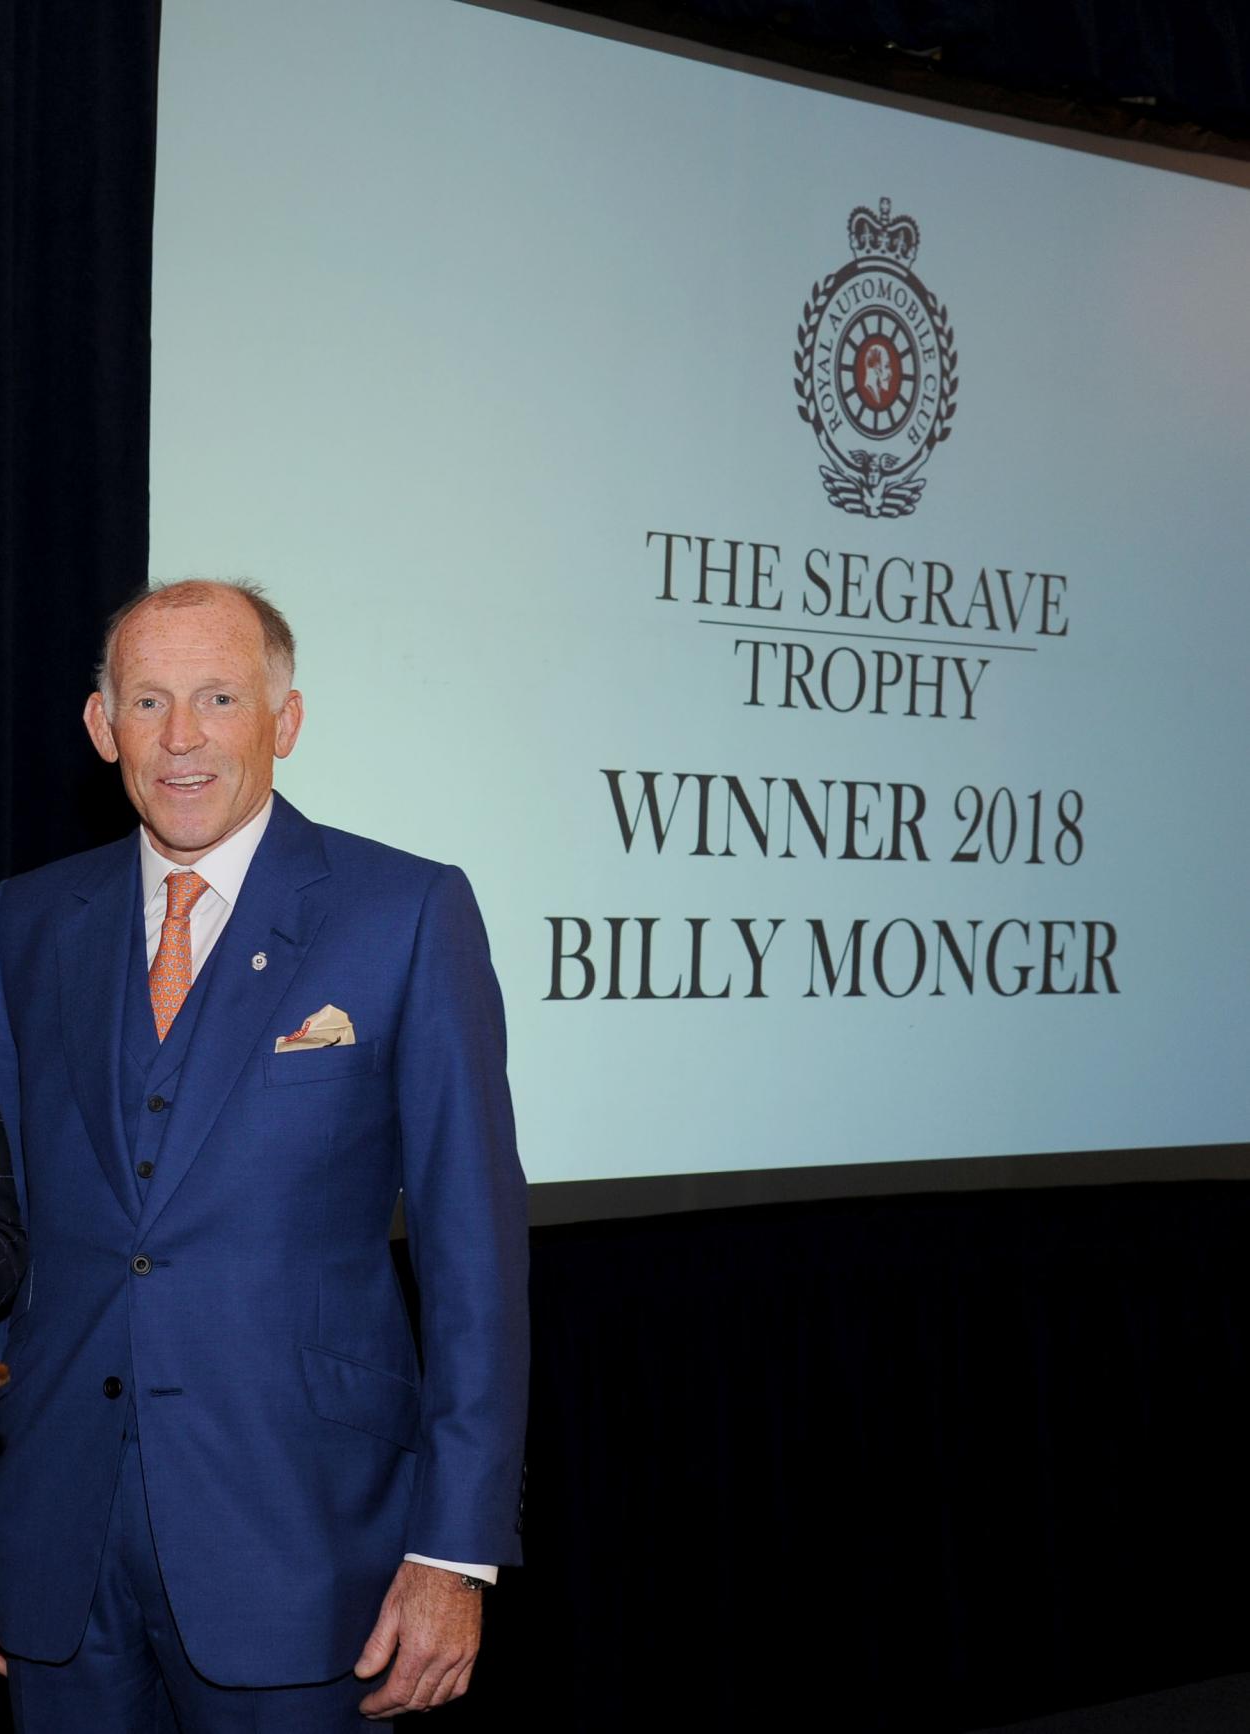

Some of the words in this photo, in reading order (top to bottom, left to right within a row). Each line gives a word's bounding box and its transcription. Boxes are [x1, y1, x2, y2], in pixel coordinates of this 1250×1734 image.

[817, 338, 843, 435] ROYAL
[830, 277, 937, 364] AUTOMOBILE
[907, 374, 938, 447] CLUB
[646, 531, 783, 611] THE
[802, 548, 1069, 637] SEGRAVE
[735, 639, 990, 720] TROPHY
[600, 769, 931, 862] WINNER
[951, 785, 1085, 866] 2018
[542, 915, 786, 1000] BILLY
[803, 918, 1121, 999] MONGER
